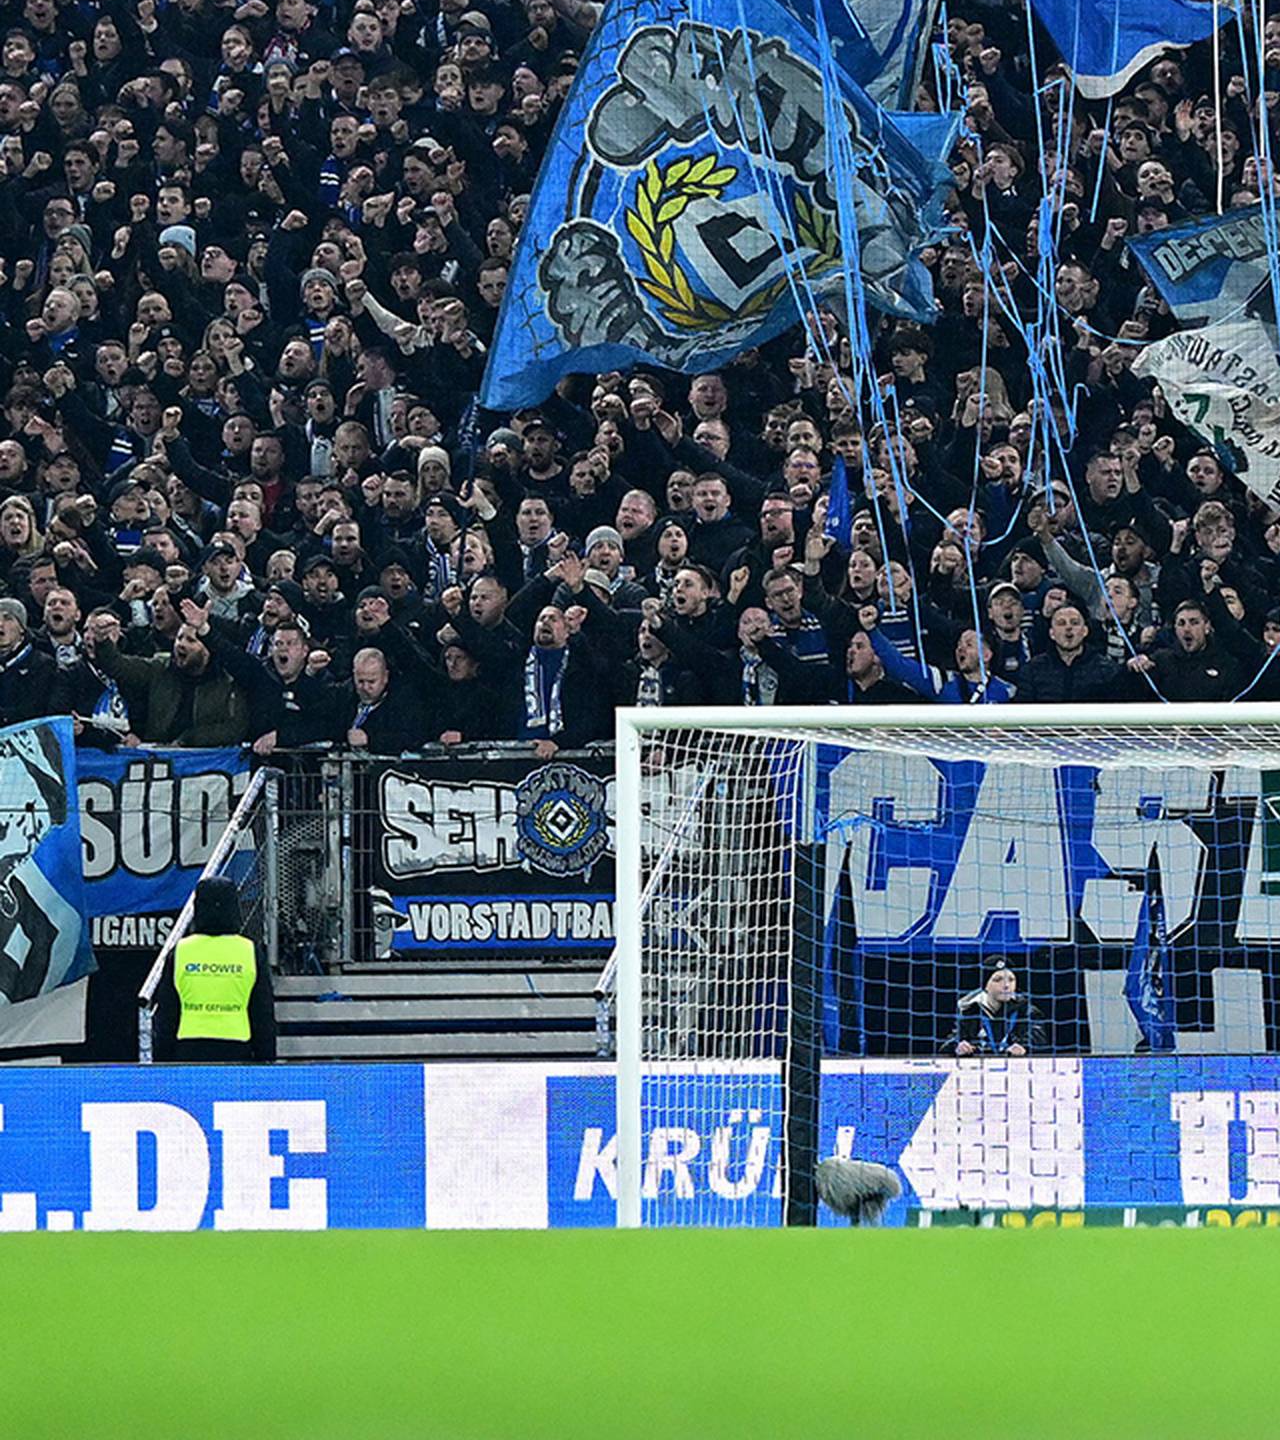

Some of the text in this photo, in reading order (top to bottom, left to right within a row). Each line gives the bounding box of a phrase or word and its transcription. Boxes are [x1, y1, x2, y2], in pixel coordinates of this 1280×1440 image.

[92, 915, 176, 947] IGANS
[407, 901, 617, 942] VORSTADTBA
[202, 963, 243, 974] POWER
[0, 1100, 328, 1231] .DE
